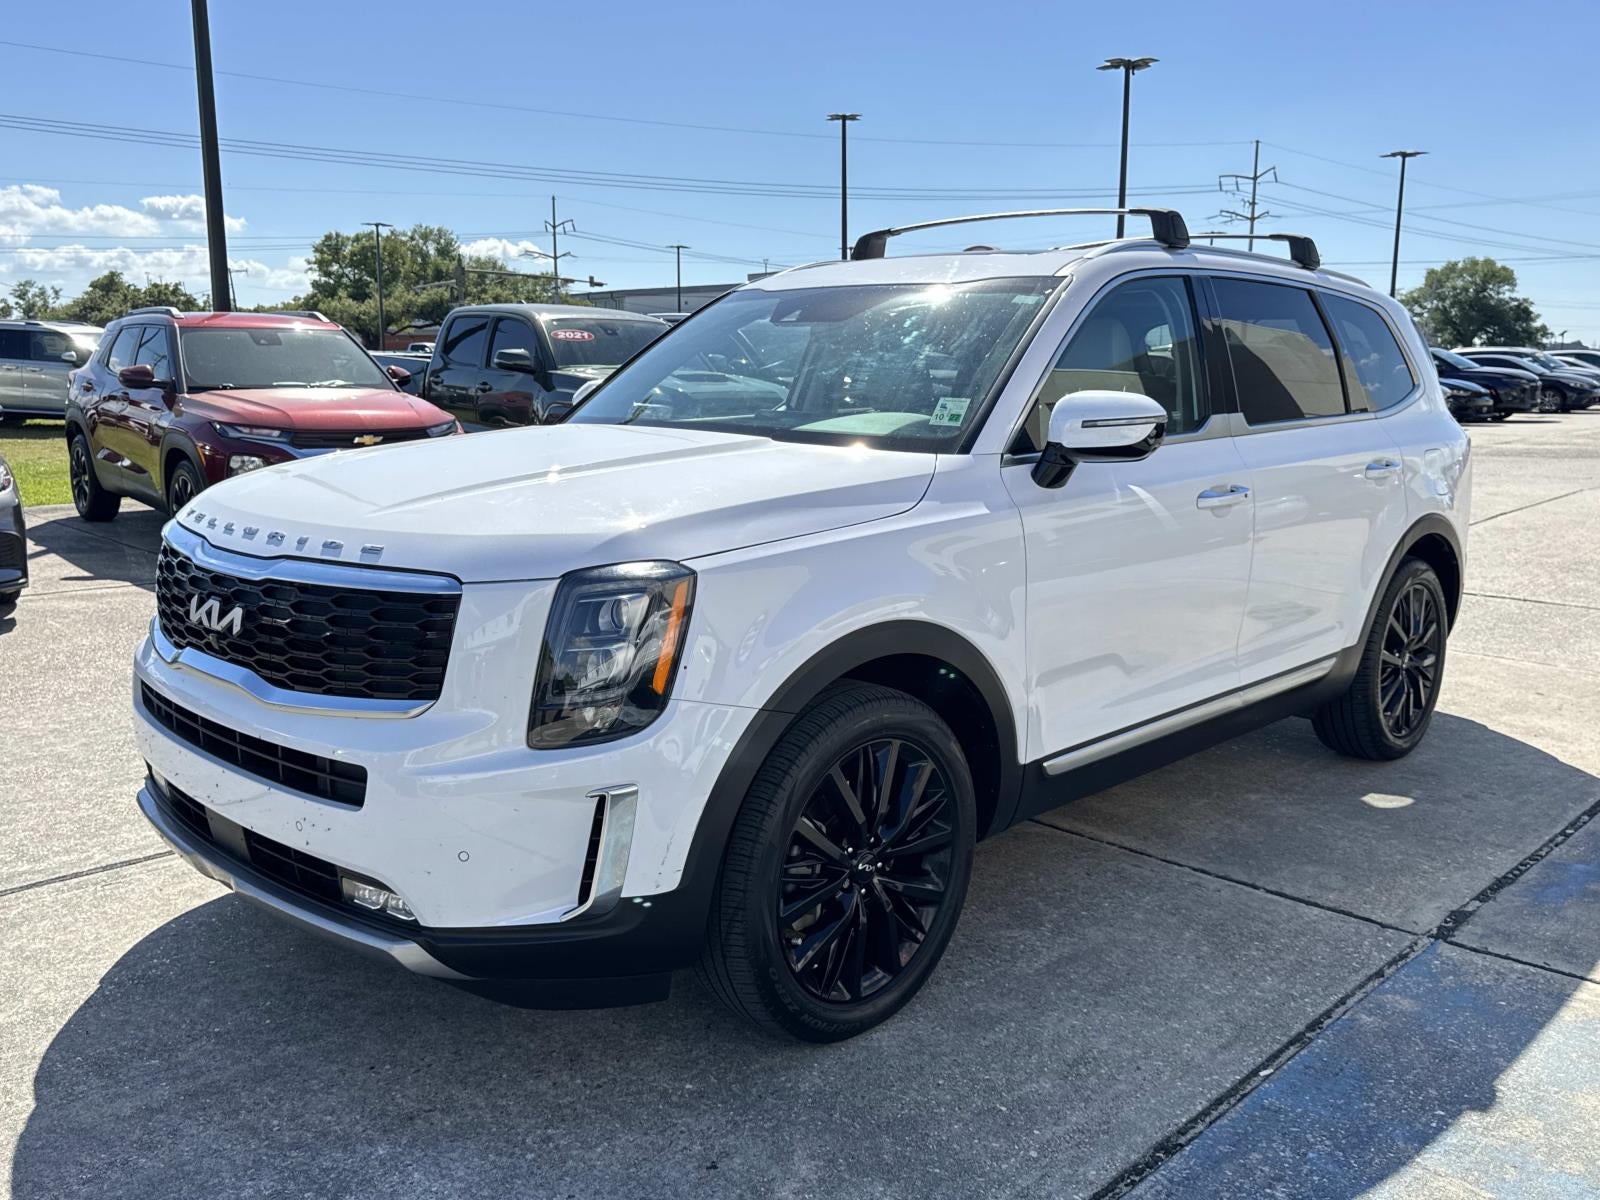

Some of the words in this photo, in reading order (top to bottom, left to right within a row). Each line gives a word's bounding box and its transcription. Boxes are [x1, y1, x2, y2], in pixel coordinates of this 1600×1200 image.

[557, 331, 589, 339] 2021
[934, 413, 945, 421] 10
[186, 508, 385, 556] TELLURIDE
[189, 594, 243, 636] KIA
